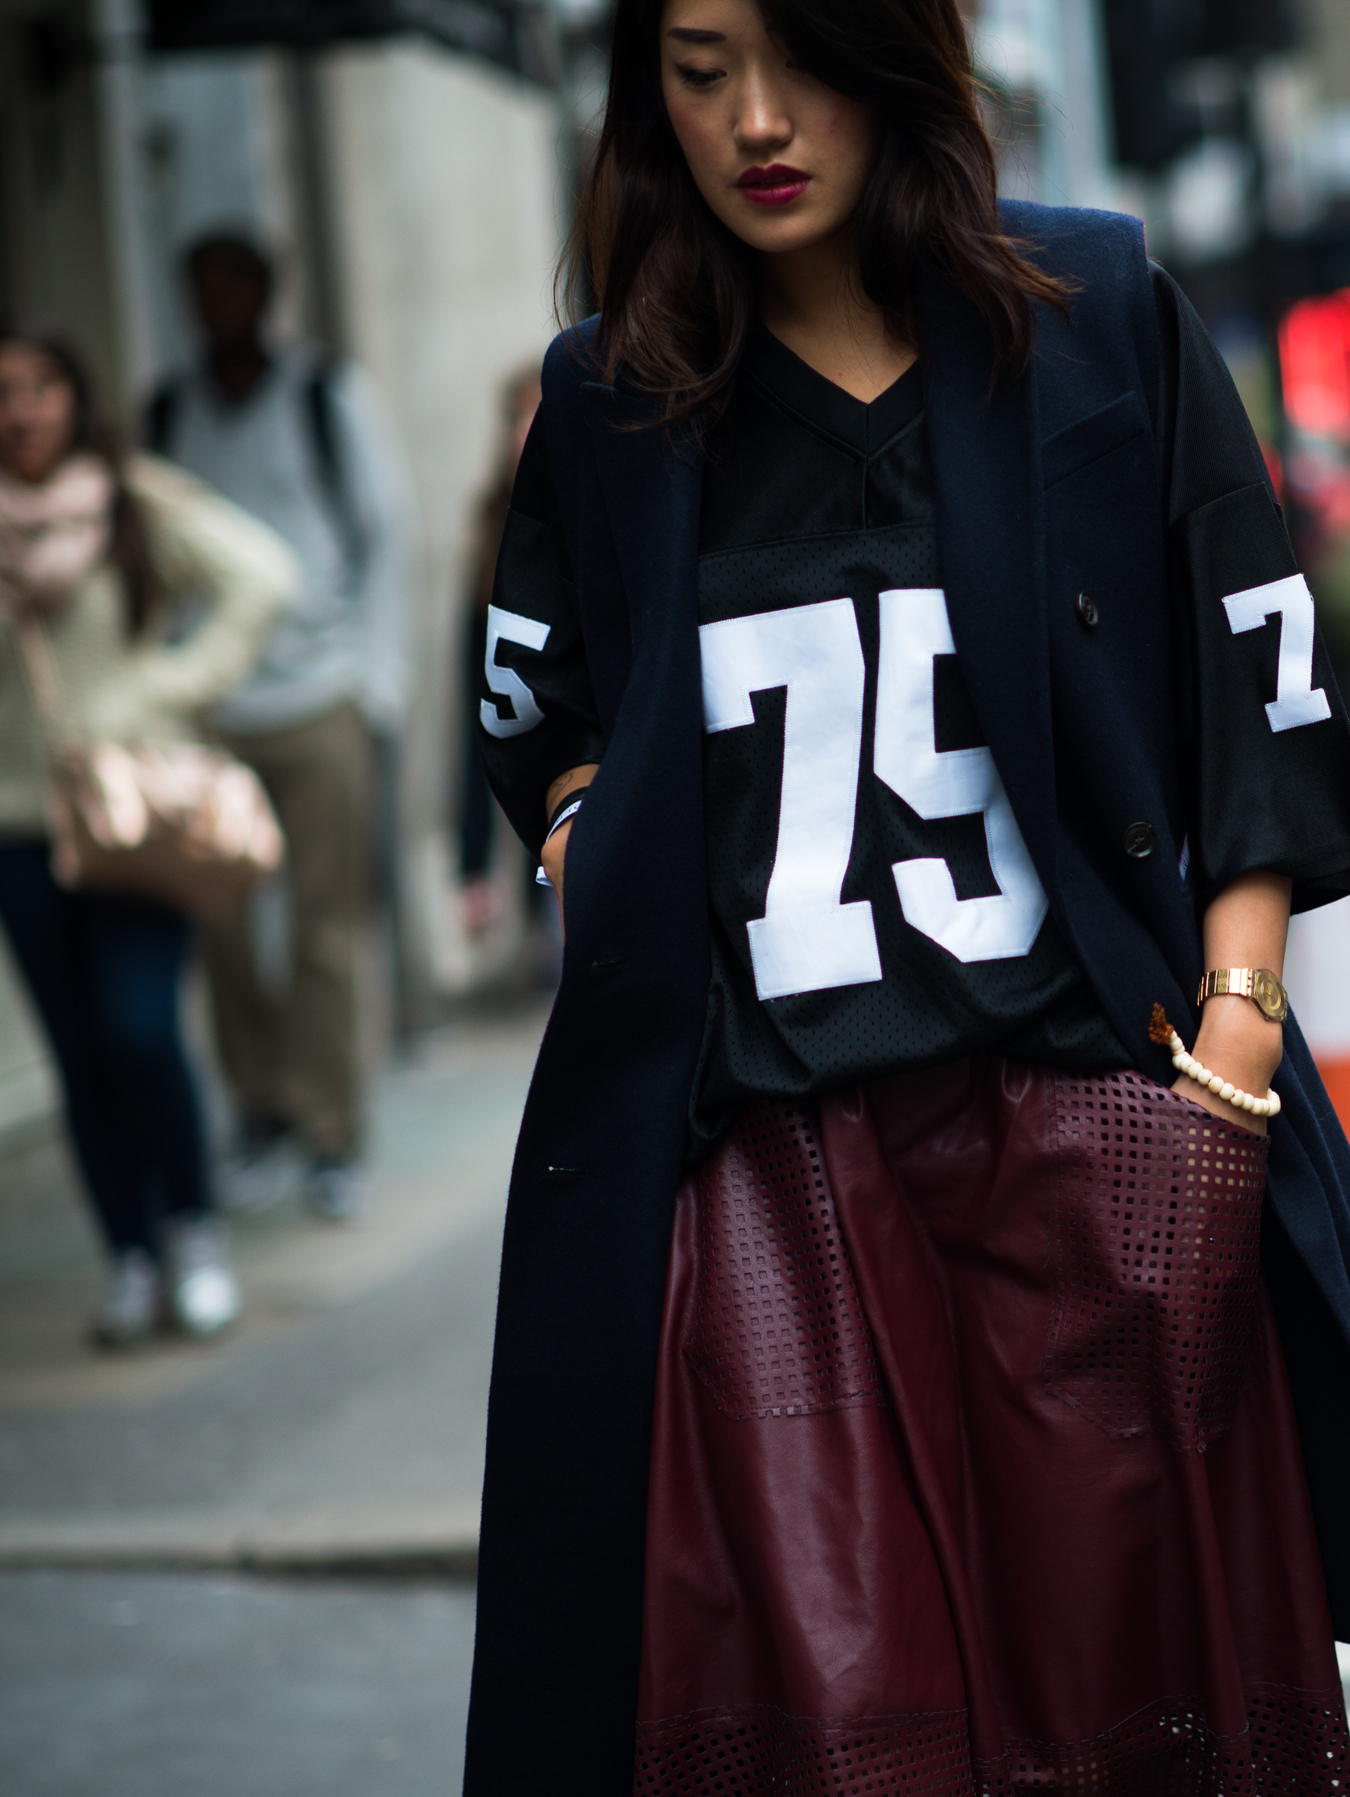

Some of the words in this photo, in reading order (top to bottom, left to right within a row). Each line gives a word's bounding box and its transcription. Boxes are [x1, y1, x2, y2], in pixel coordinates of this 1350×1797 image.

[480, 604, 551, 739] 5
[1221, 573, 1332, 733] 7
[699, 588, 1049, 1000] 75
